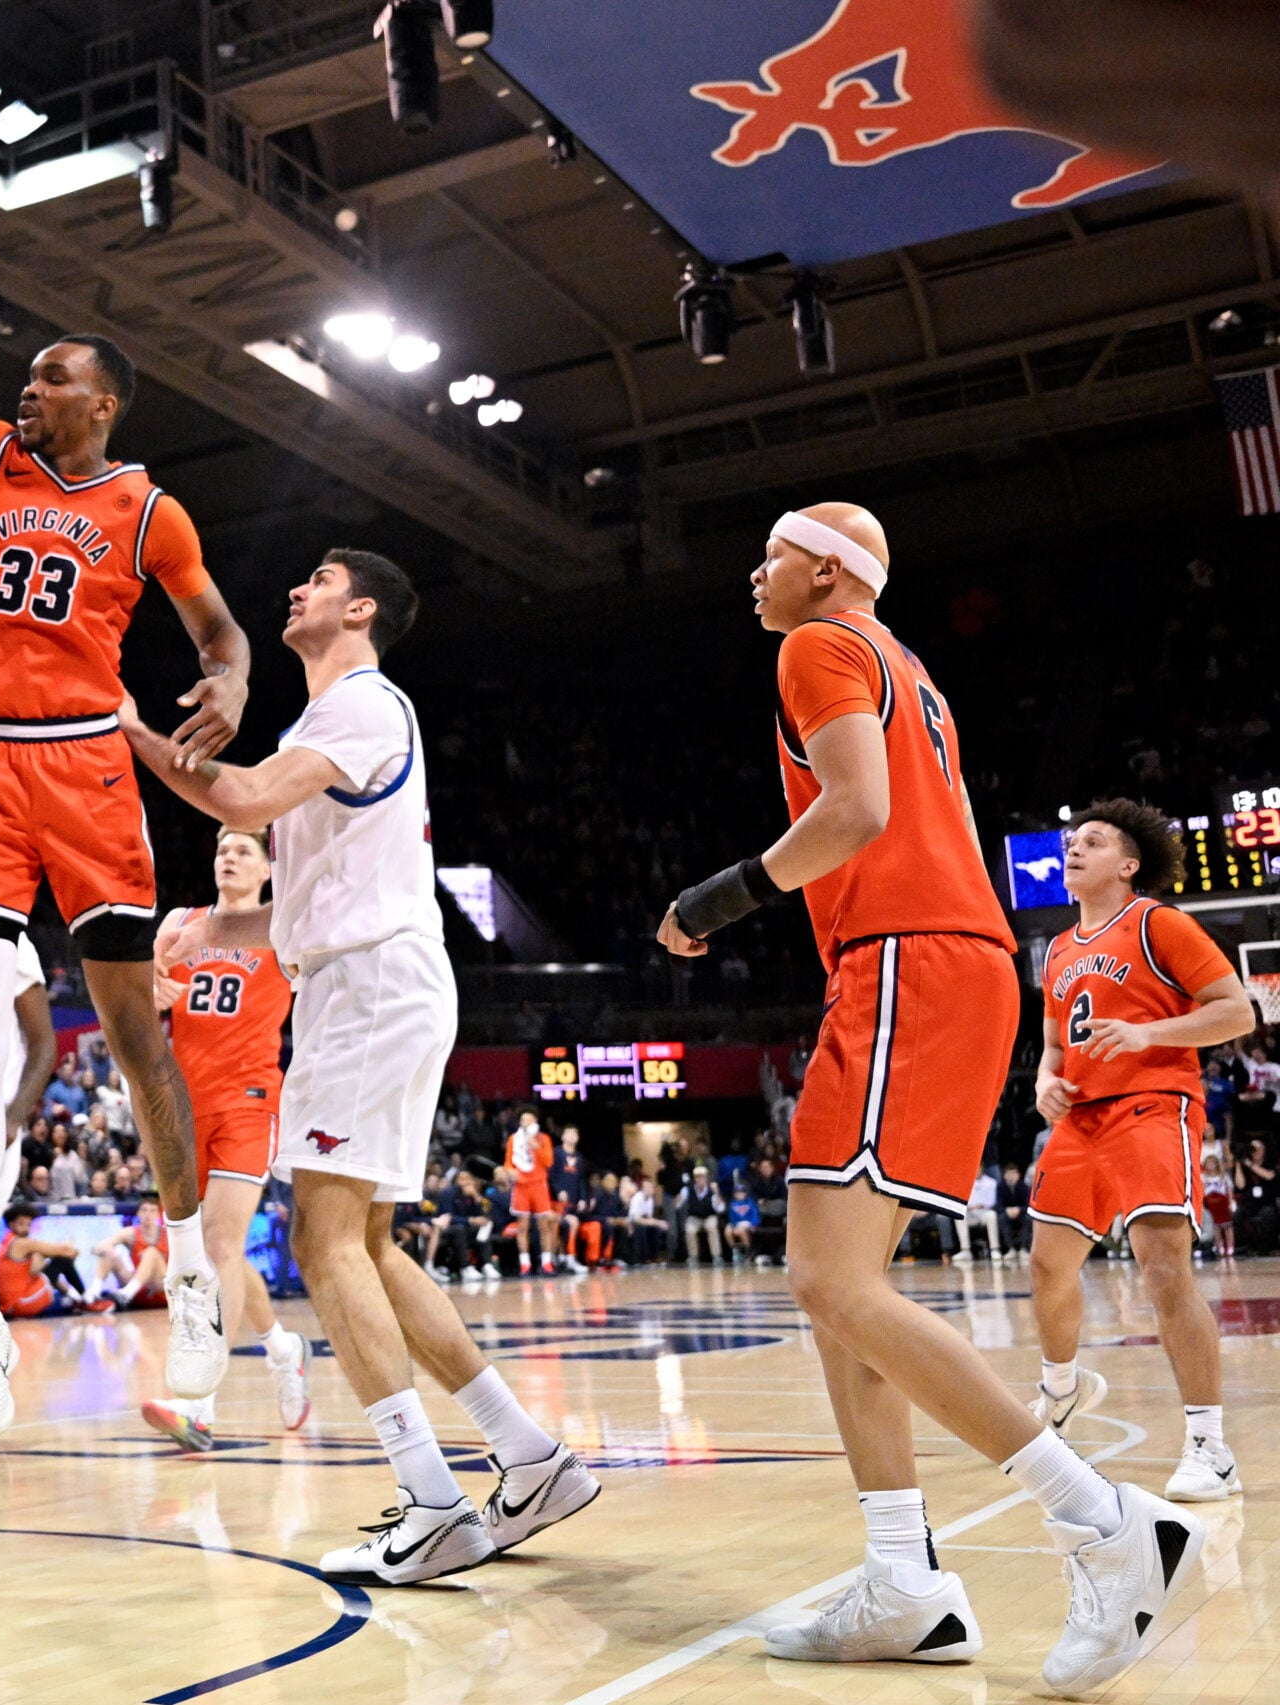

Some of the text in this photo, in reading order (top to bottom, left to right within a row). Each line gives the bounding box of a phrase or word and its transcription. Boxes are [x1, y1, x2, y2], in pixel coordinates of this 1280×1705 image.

[1235, 808, 1280, 847] 23
[187, 971, 244, 1017] 28
[1052, 953, 1131, 1002] VIRGINIA
[1068, 989, 1094, 1047] 2
[540, 1061, 576, 1085] 50
[643, 1060, 678, 1083] 50
